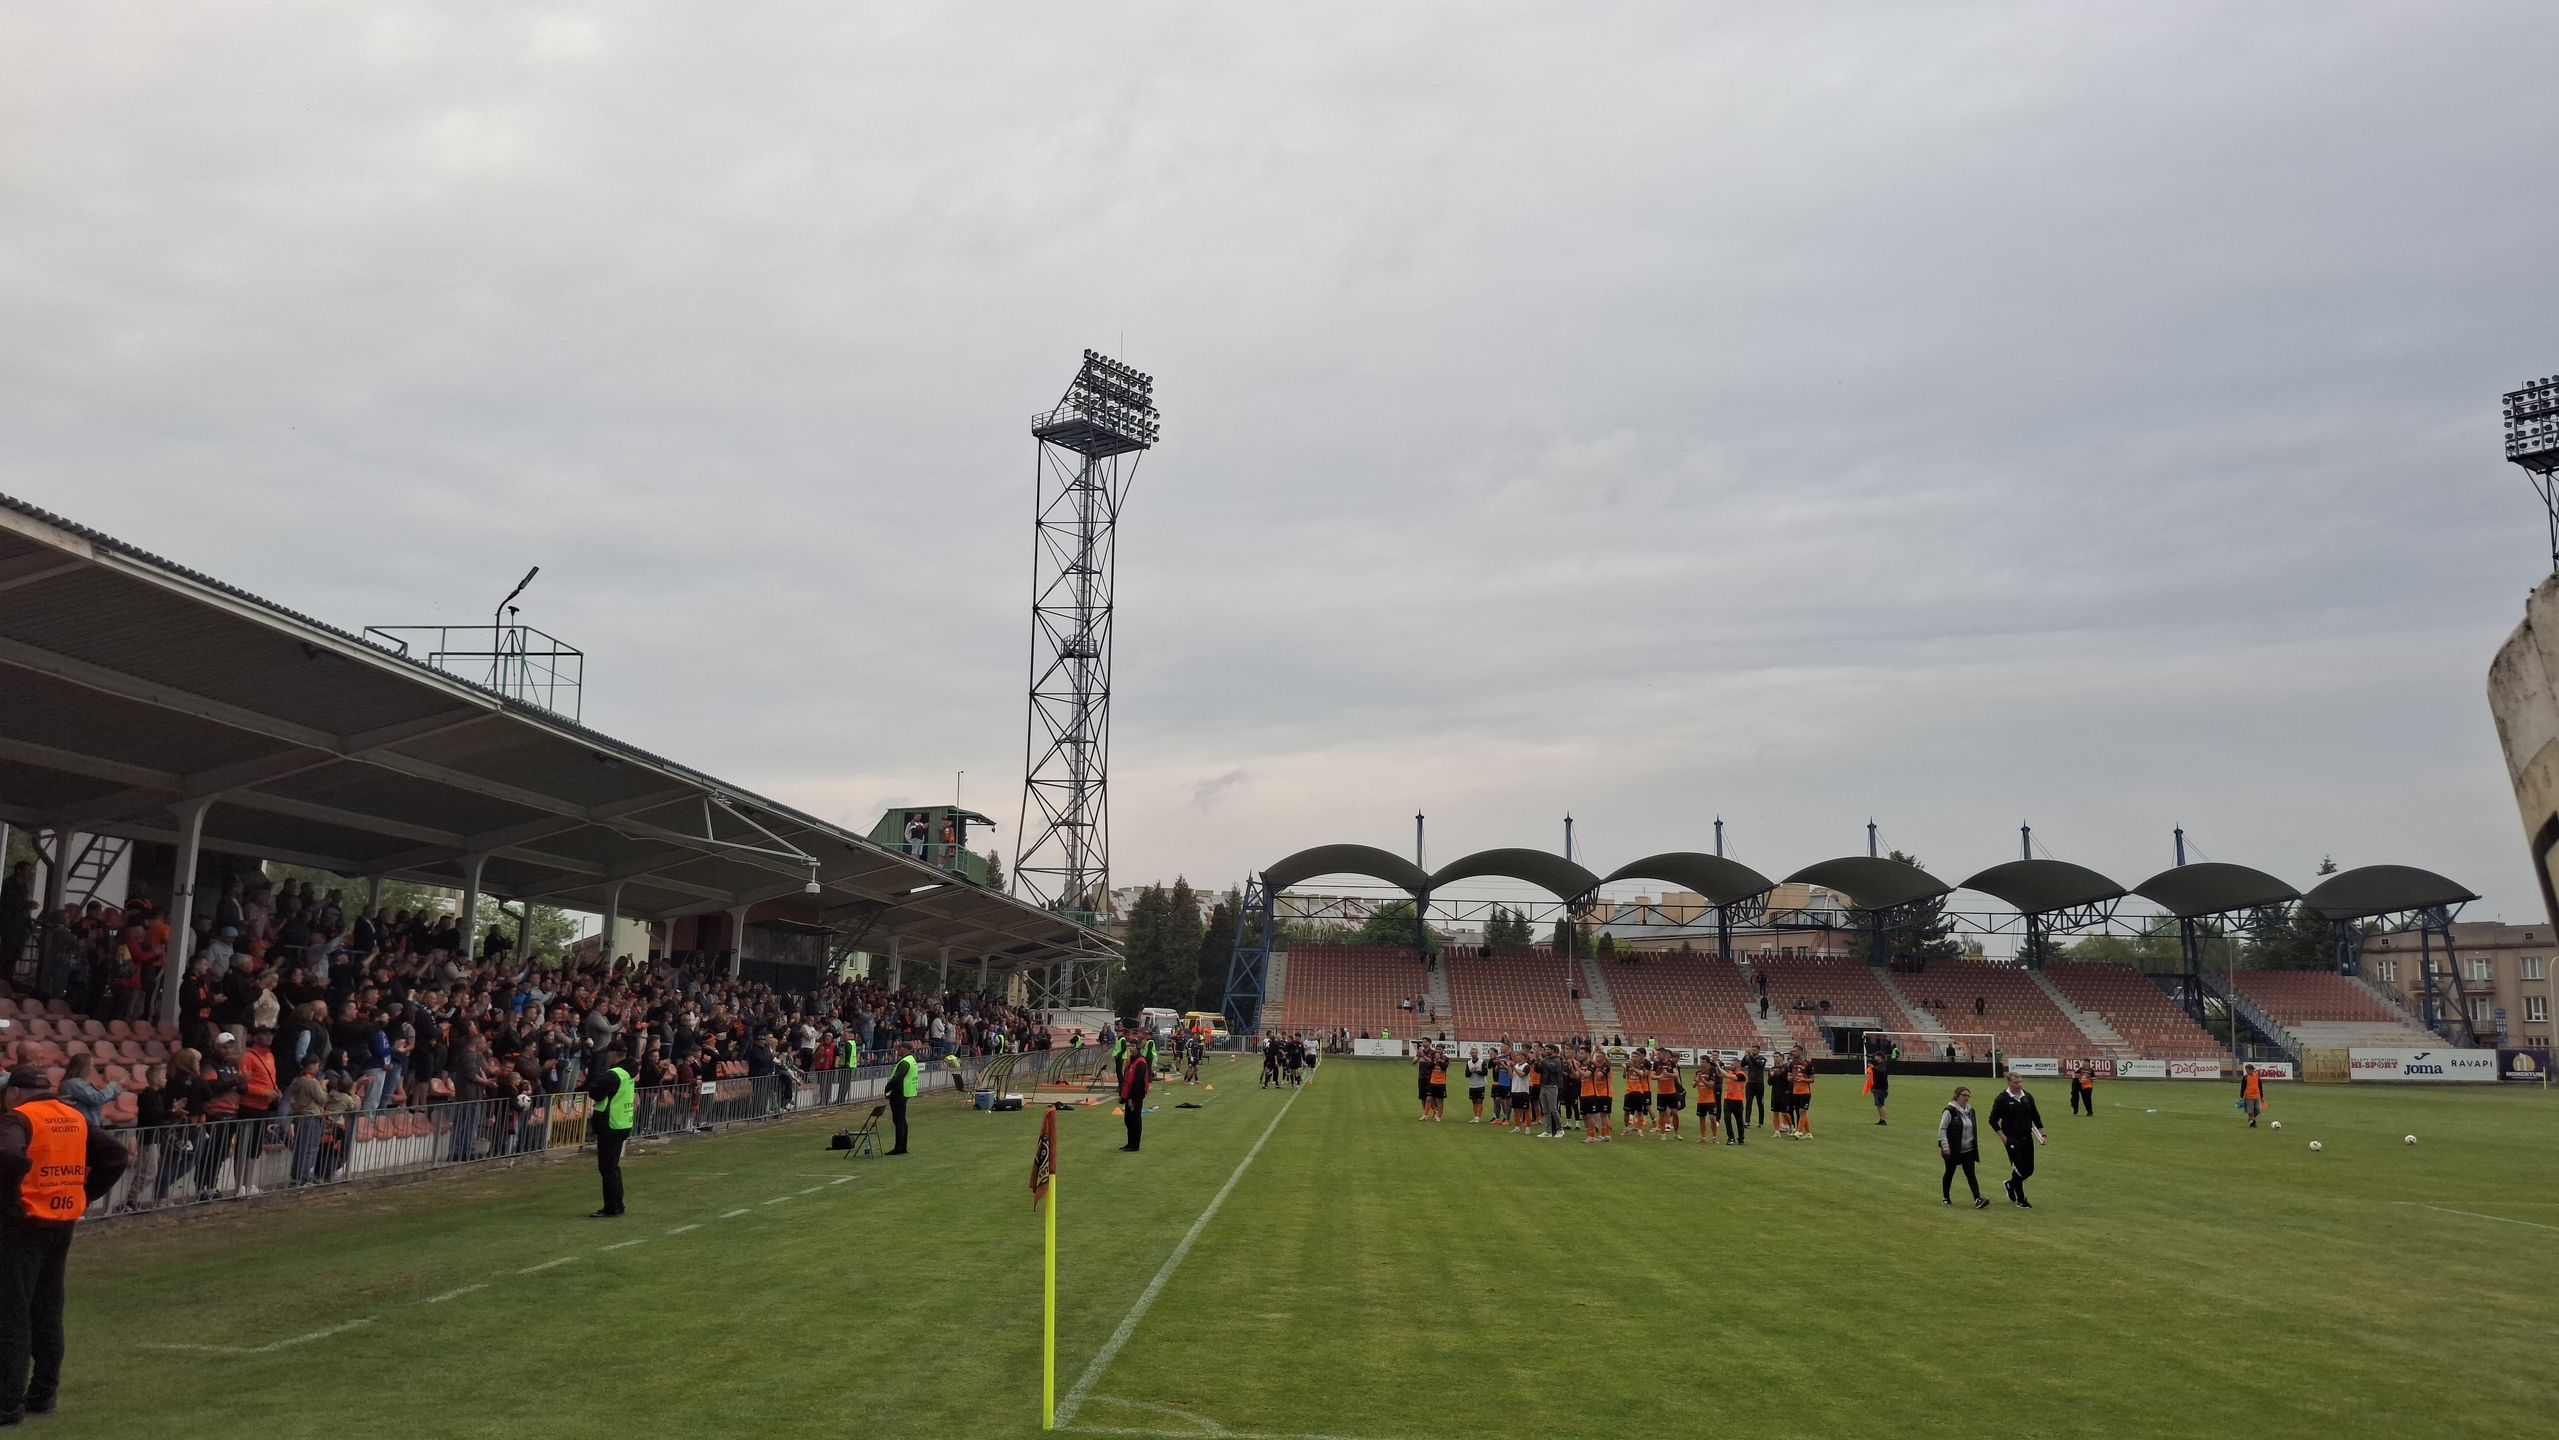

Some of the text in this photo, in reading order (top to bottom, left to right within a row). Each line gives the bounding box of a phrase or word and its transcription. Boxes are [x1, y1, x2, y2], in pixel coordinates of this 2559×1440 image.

[2066, 1059, 2112, 1072] NEXERIO
[2451, 1059, 2493, 1068] RAVAPI
[50, 1196, 74, 1210] 016
